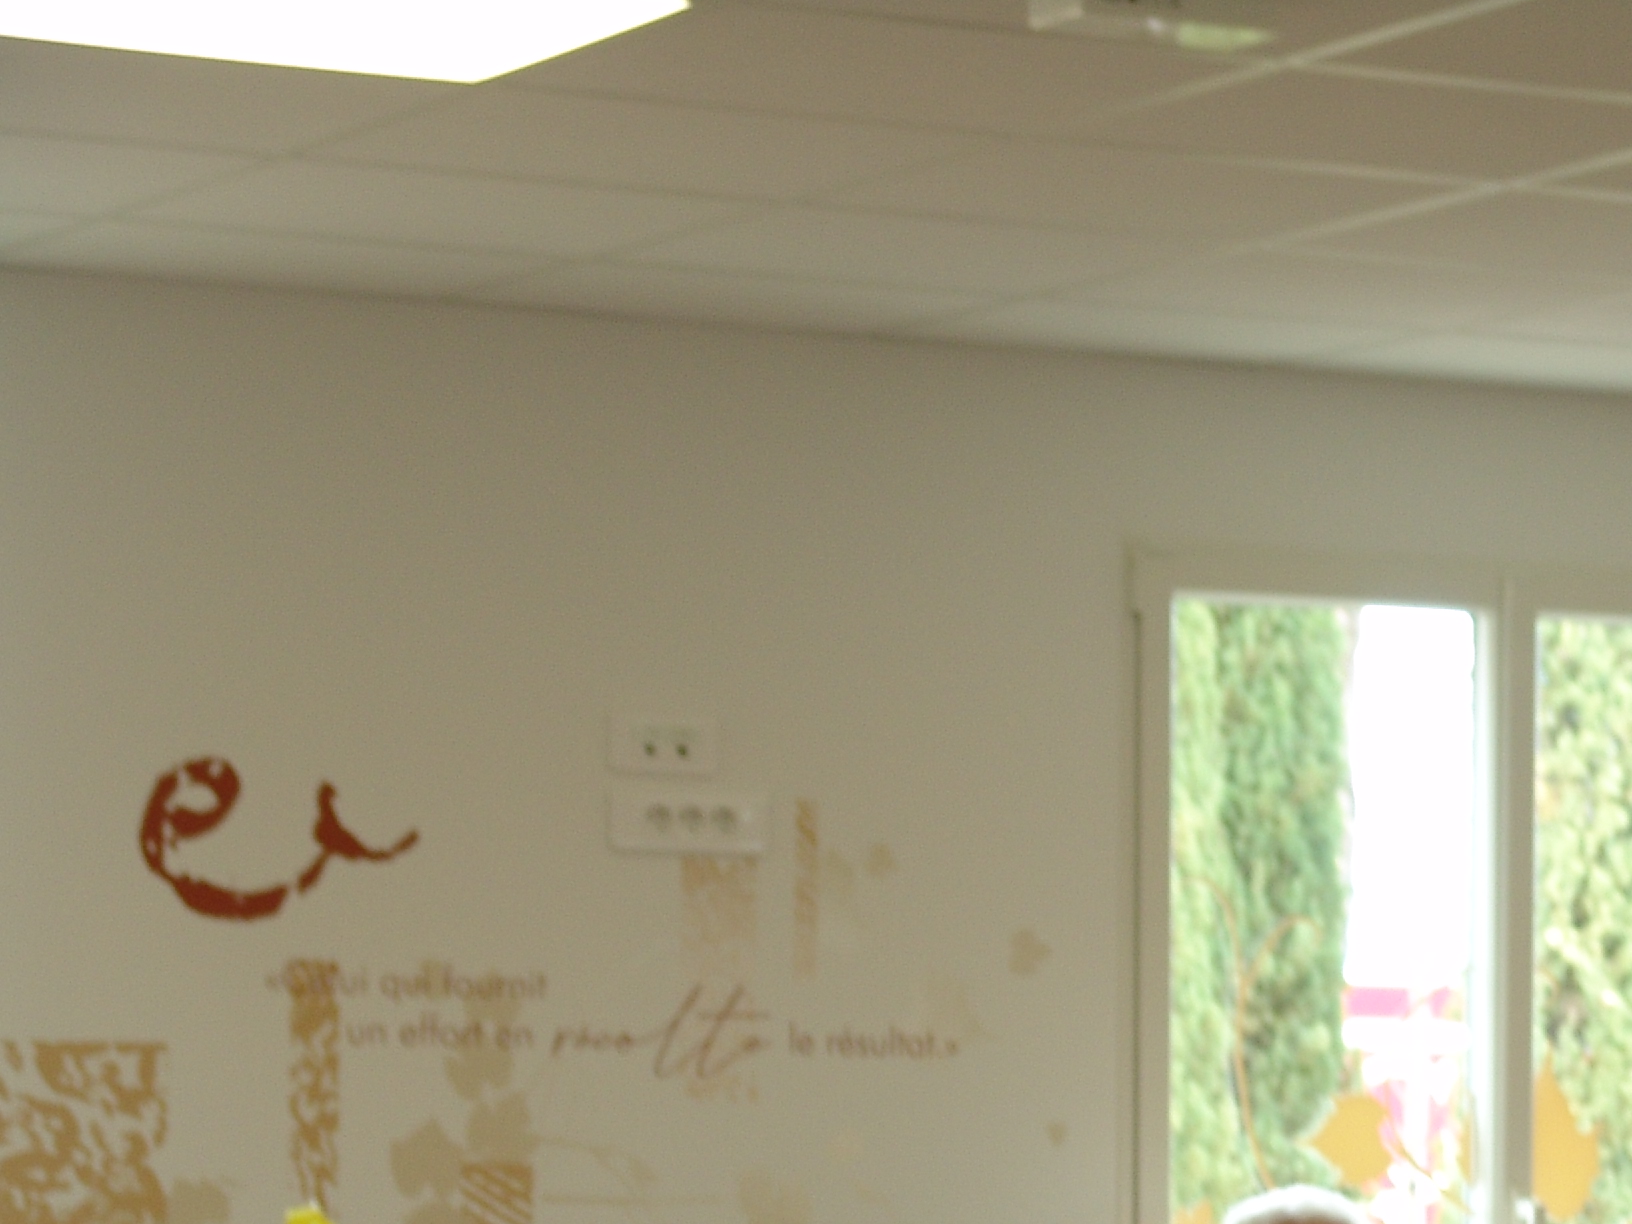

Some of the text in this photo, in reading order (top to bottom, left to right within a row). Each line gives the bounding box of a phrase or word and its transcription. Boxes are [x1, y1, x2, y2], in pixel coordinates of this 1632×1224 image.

[346, 1021, 388, 1048] un
[397, 1013, 482, 1049] effort
[495, 1025, 535, 1052] en
[787, 1019, 815, 1056] le
